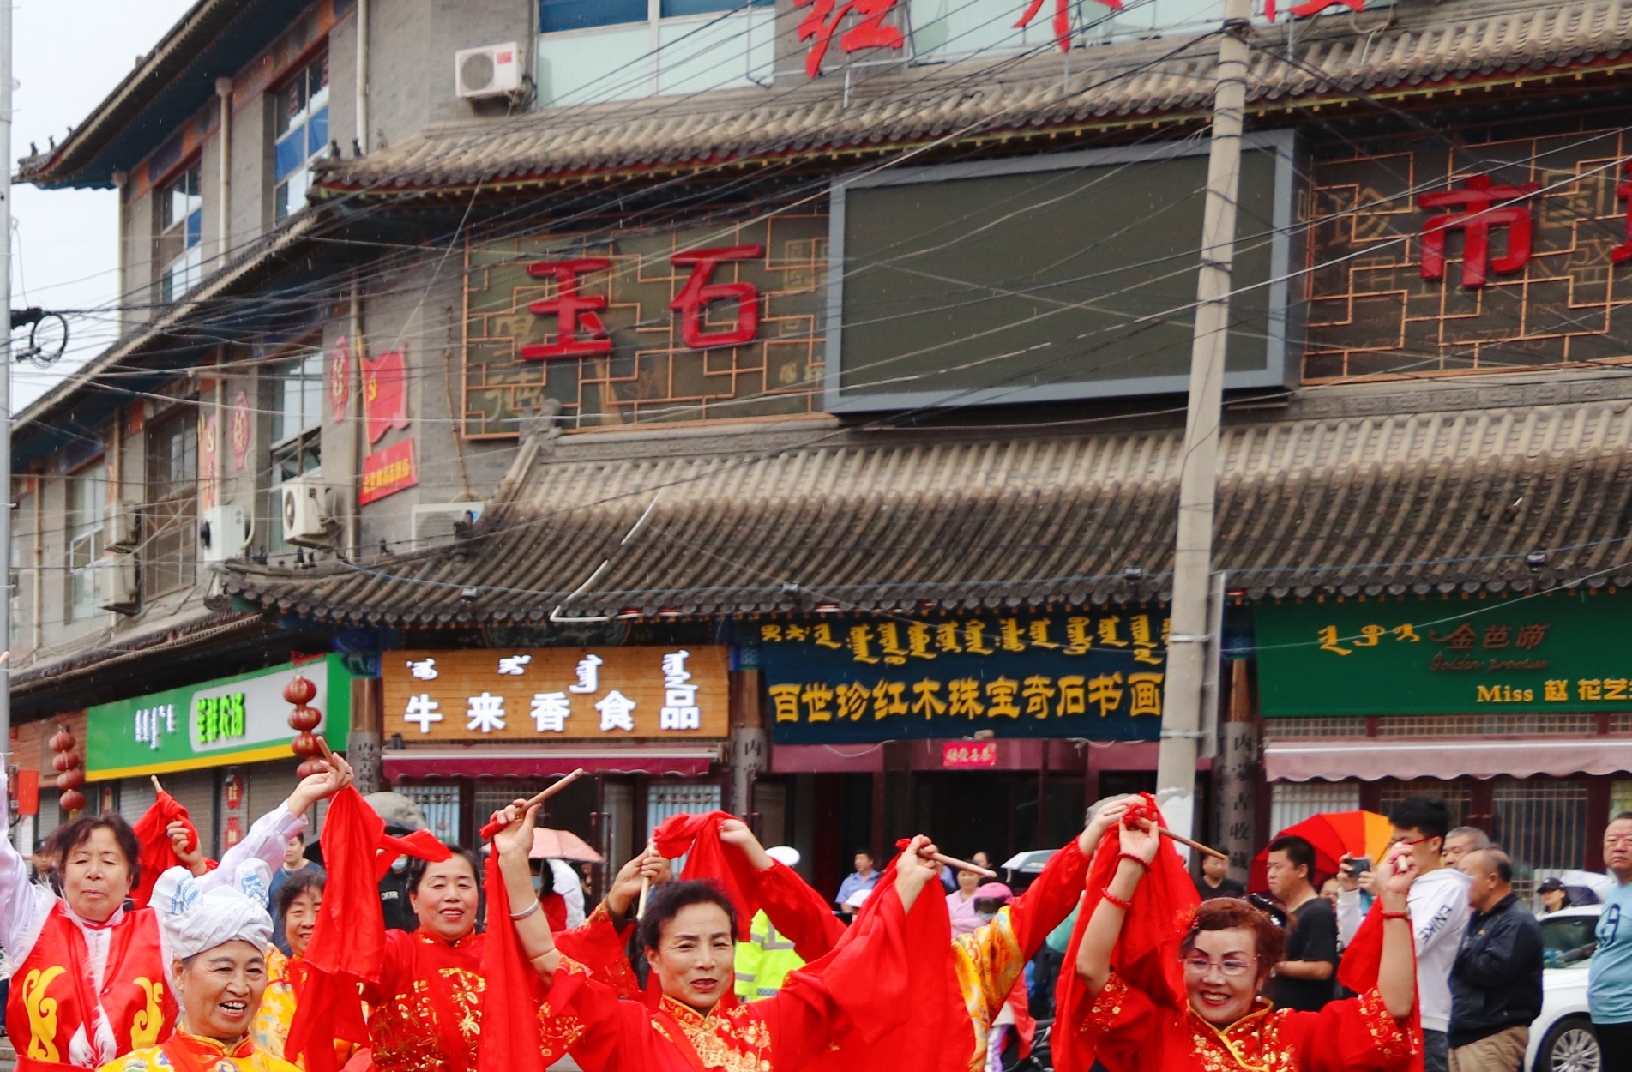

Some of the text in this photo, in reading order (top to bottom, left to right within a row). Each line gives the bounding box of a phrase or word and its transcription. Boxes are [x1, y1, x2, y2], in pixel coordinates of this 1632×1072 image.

[520, 243, 763, 359] 玉石
[404, 689, 700, 734] 牛来香食品
[769, 671, 1164, 723] 百世珍红木珠宝奇石书画
[1476, 685, 1534, 702] Miss
[1577, 678, 1632, 701] 花艺
